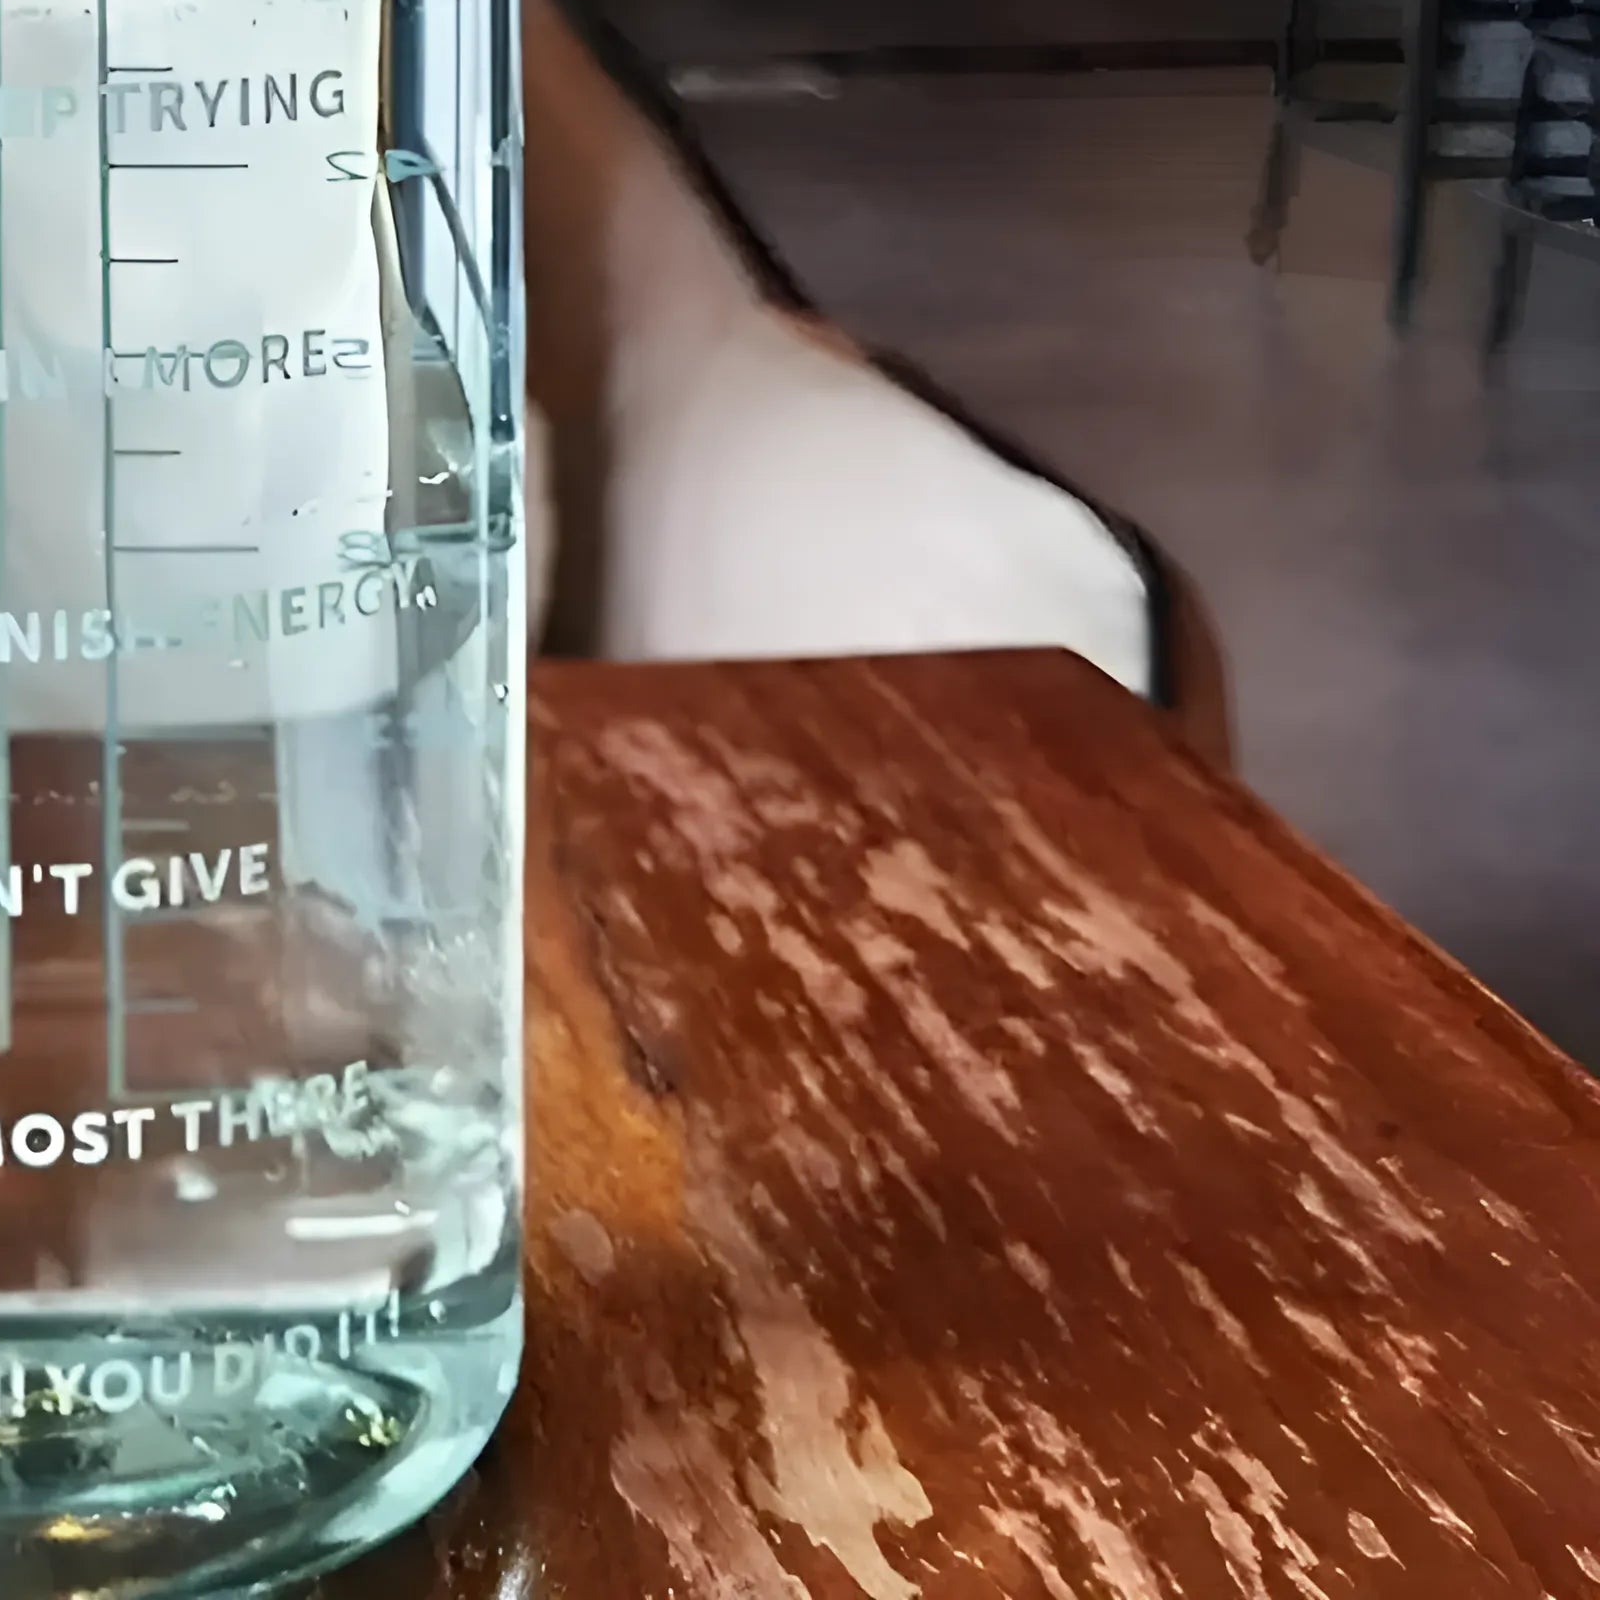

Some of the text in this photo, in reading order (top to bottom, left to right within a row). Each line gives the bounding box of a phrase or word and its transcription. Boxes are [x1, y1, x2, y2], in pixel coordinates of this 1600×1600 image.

[100, 70, 345, 134] TRYING
[111, 842, 270, 911] GIVE
[43, 1350, 193, 1415] YOU
